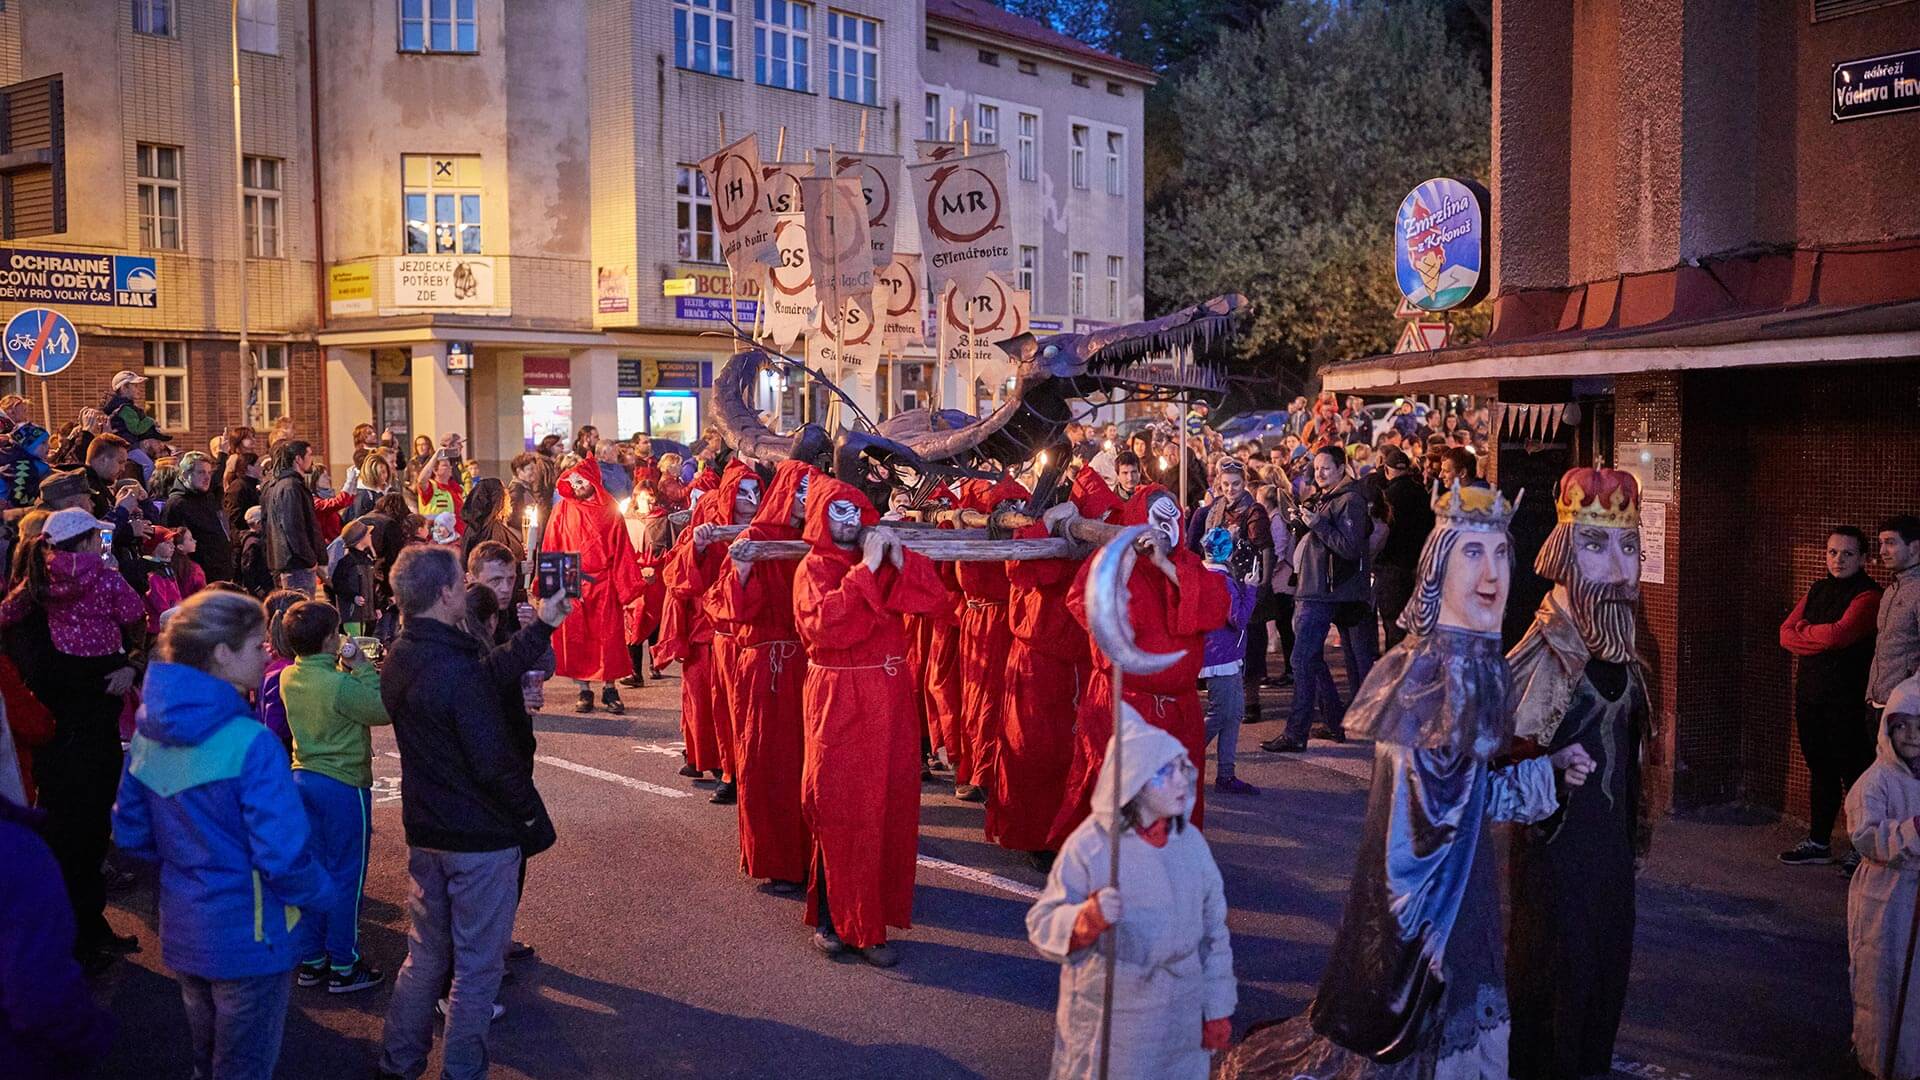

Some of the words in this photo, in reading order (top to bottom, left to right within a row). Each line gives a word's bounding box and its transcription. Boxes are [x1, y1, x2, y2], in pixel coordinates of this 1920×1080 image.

[1863, 62, 1904, 79] nábřeží
[1837, 83, 1888, 107] Václava
[941, 190, 988, 216] MR
[1404, 196, 1469, 239] Zmrzlina
[1418, 242, 1425, 253] z
[1424, 219, 1472, 249] Krkonoš
[10, 254, 111, 274] OCHRANNÉ
[400, 260, 453, 272] JEZDECKÉ
[50, 272, 111, 290] ODĚVY
[403, 272, 450, 287] POTŘEBY
[30, 289, 52, 299] PRO
[54, 289, 88, 300] VOLNÝ
[90, 290, 112, 302] ČAS
[119, 292, 153, 306] BMK
[417, 290, 437, 301] ZDE
